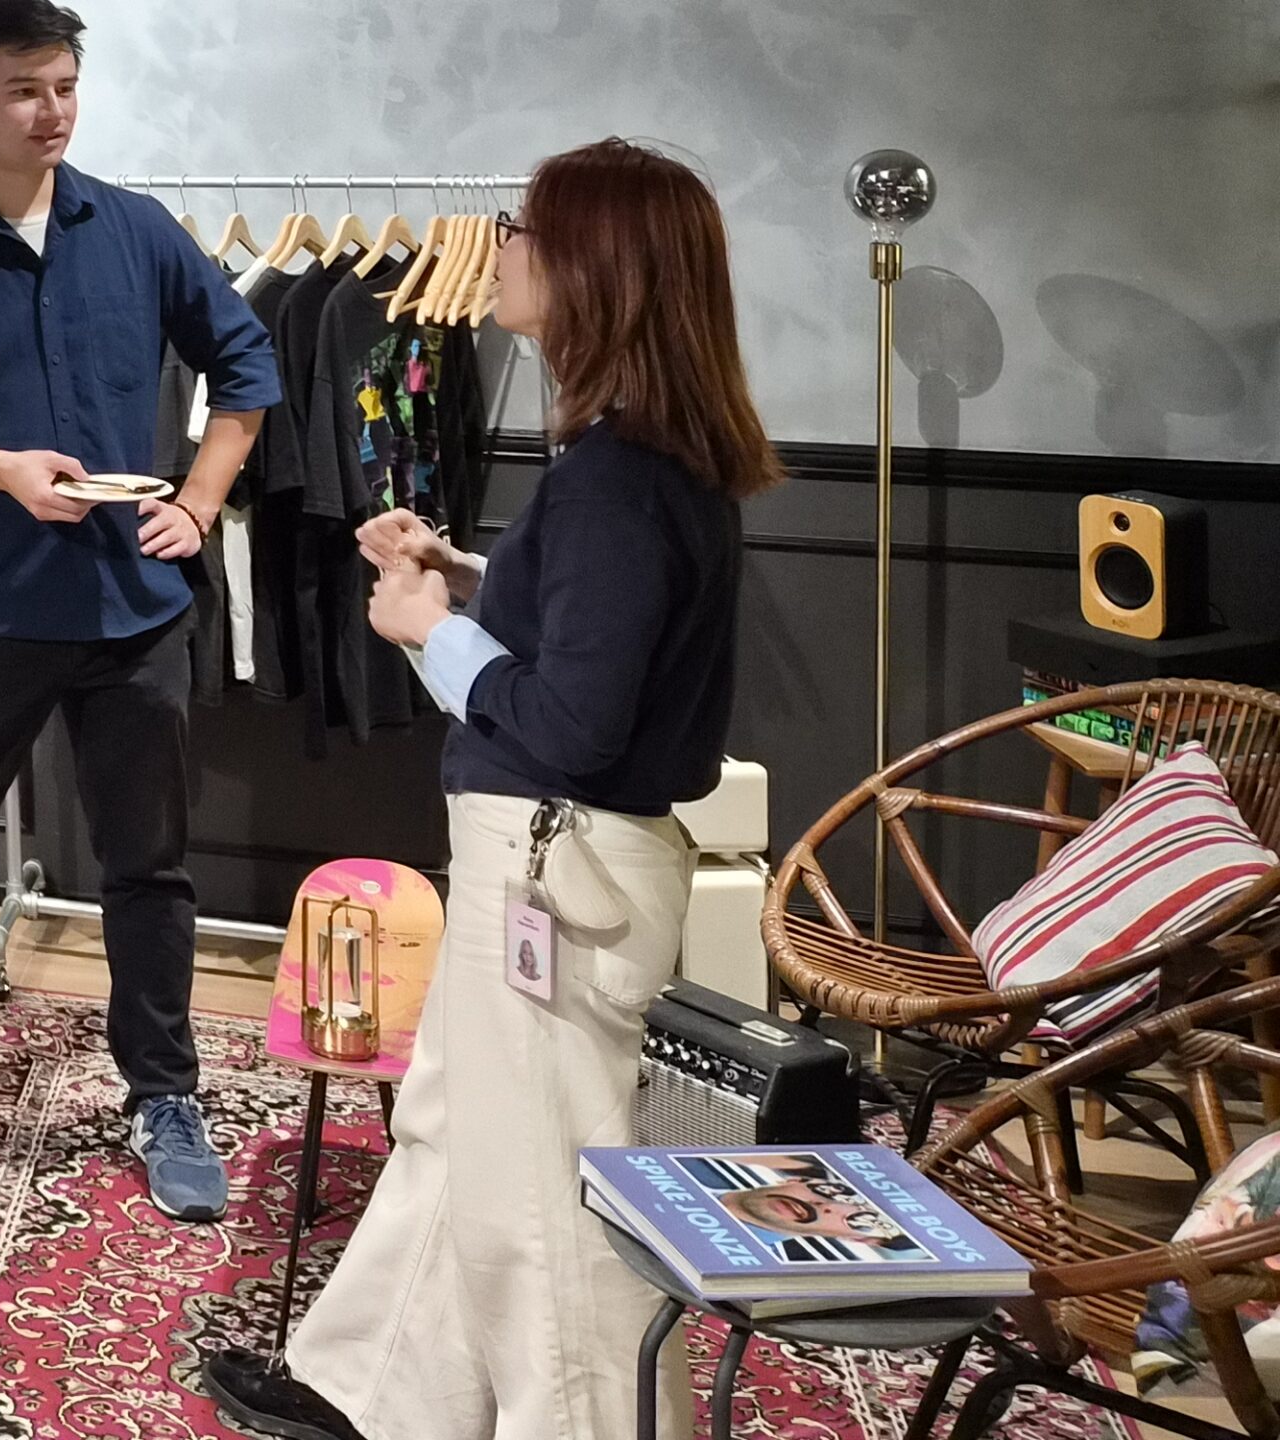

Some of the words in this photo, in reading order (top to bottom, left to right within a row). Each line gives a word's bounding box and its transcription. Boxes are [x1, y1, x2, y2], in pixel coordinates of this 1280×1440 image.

[625, 1155, 696, 1202] SPIKE
[674, 1204, 763, 1266] JONZE
[834, 1151, 928, 1213] BEASTIE
[911, 1215, 987, 1263] BOYS
